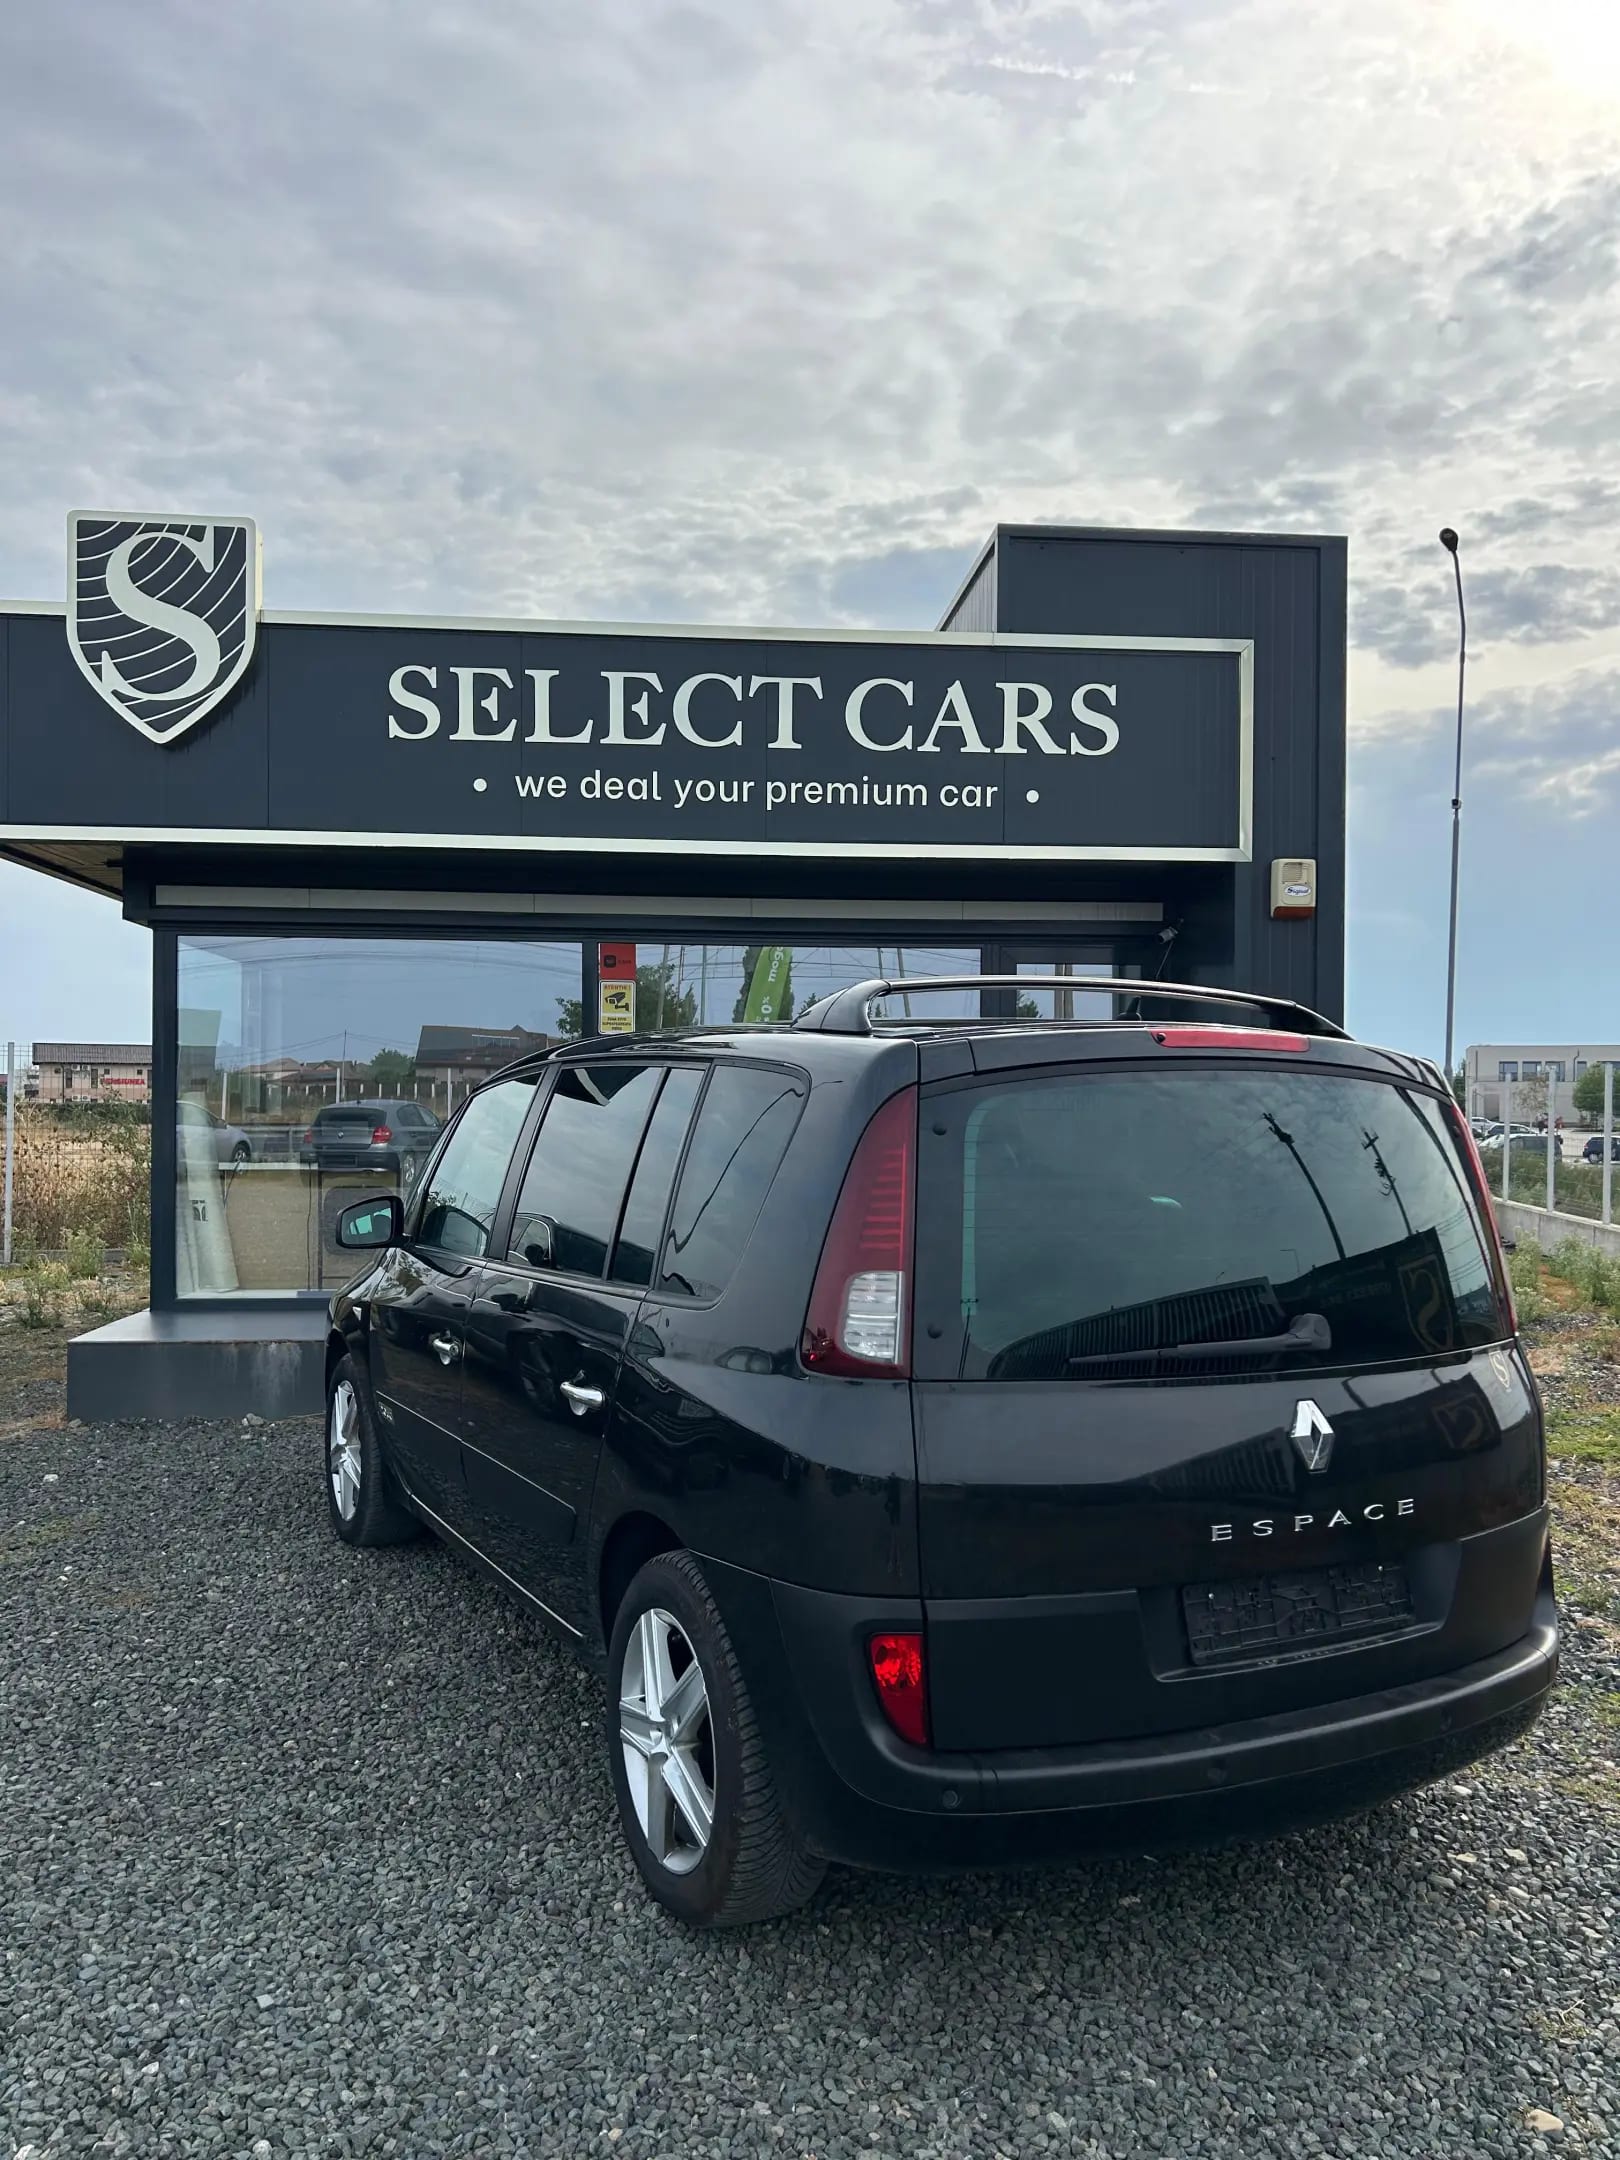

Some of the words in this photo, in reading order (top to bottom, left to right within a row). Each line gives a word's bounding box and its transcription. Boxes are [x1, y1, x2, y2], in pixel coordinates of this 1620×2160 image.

[102, 525, 220, 700] S
[388, 664, 824, 748] SELECT
[845, 678, 1120, 756] CARS
[514, 775, 567, 798] we
[580, 769, 662, 801] deal
[673, 778, 755, 809] your
[766, 775, 928, 811] premium
[939, 784, 999, 808] car
[1210, 1498, 1415, 1542] ESPACE
